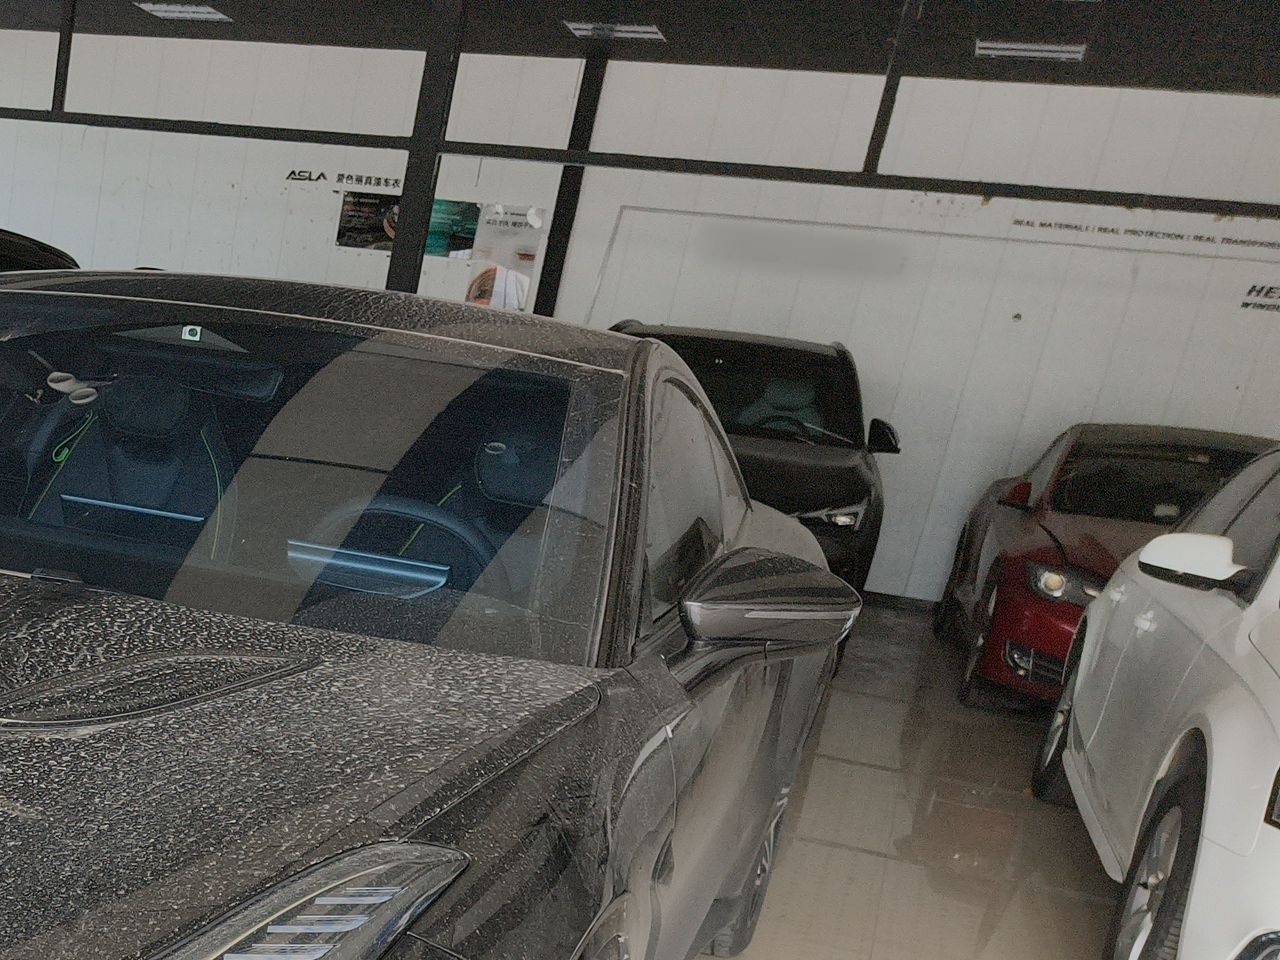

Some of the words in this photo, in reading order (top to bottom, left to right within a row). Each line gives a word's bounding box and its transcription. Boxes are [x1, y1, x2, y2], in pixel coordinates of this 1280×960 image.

[286, 170, 327, 181] ASLA
[1097, 226, 1119, 235] REAL
[1193, 234, 1216, 243] REAL
